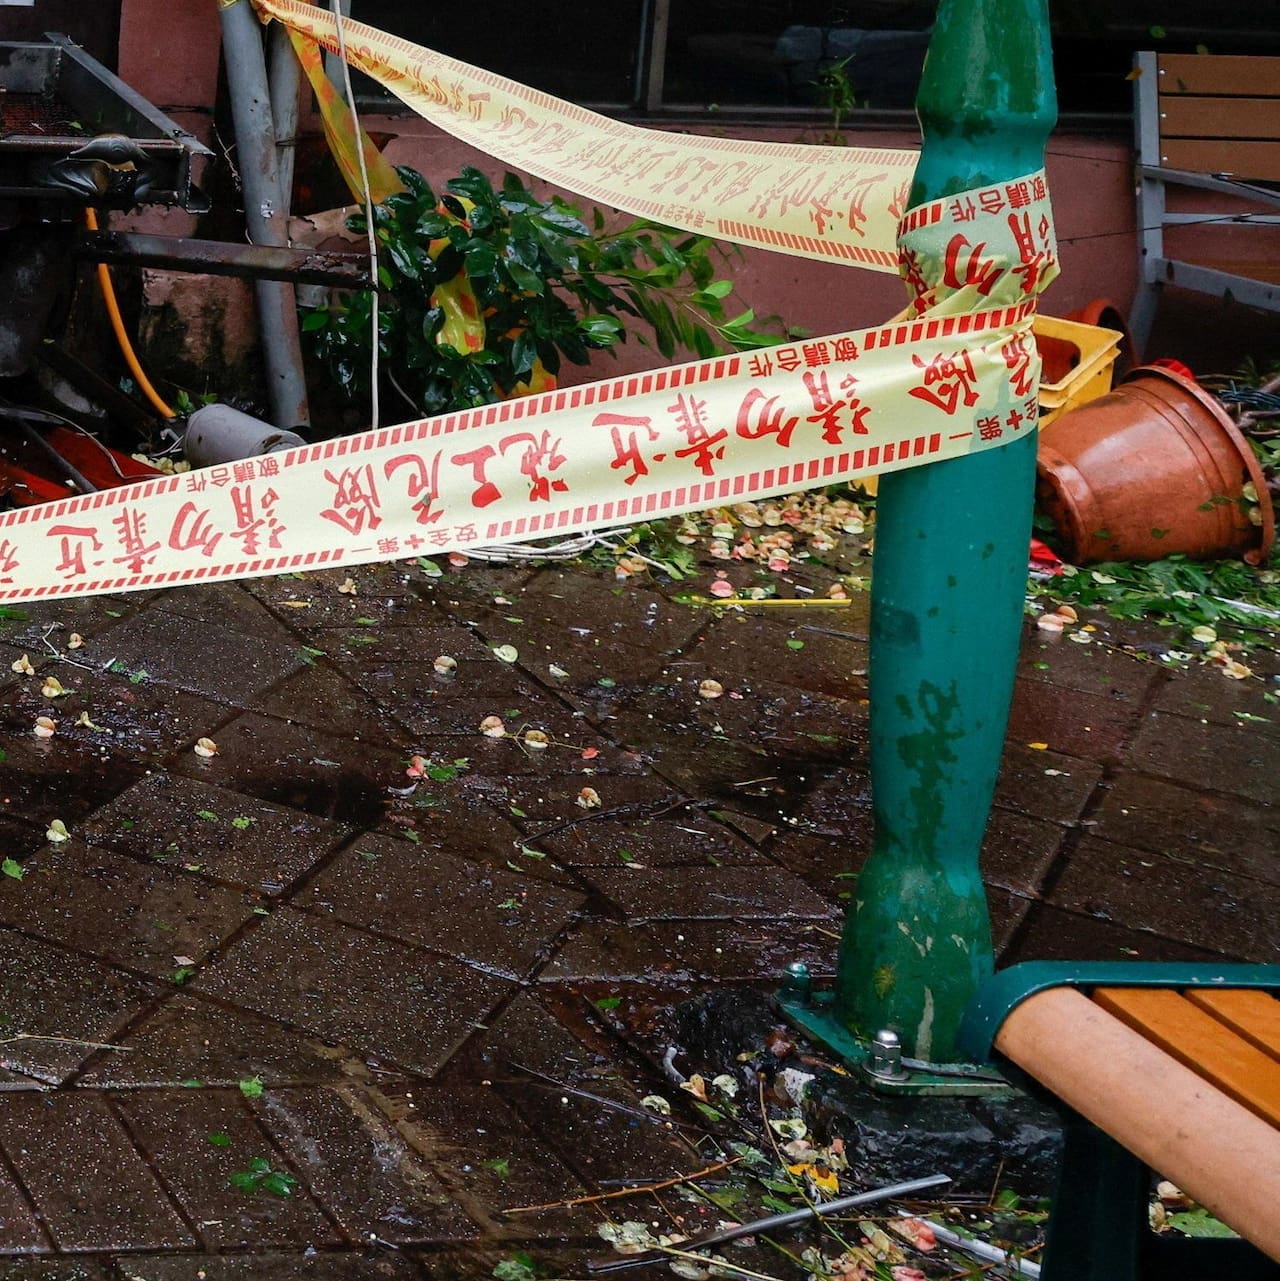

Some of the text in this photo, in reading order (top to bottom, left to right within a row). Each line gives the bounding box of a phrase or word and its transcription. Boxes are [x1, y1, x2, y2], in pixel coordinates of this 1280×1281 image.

[748, 337, 859, 377] 敬請合作
[186, 457, 279, 492] 敬請合作
[592, 371, 872, 486] 請勿靠近
[320, 429, 569, 536] 施工危險
[47, 485, 287, 579] 請勿靠近
